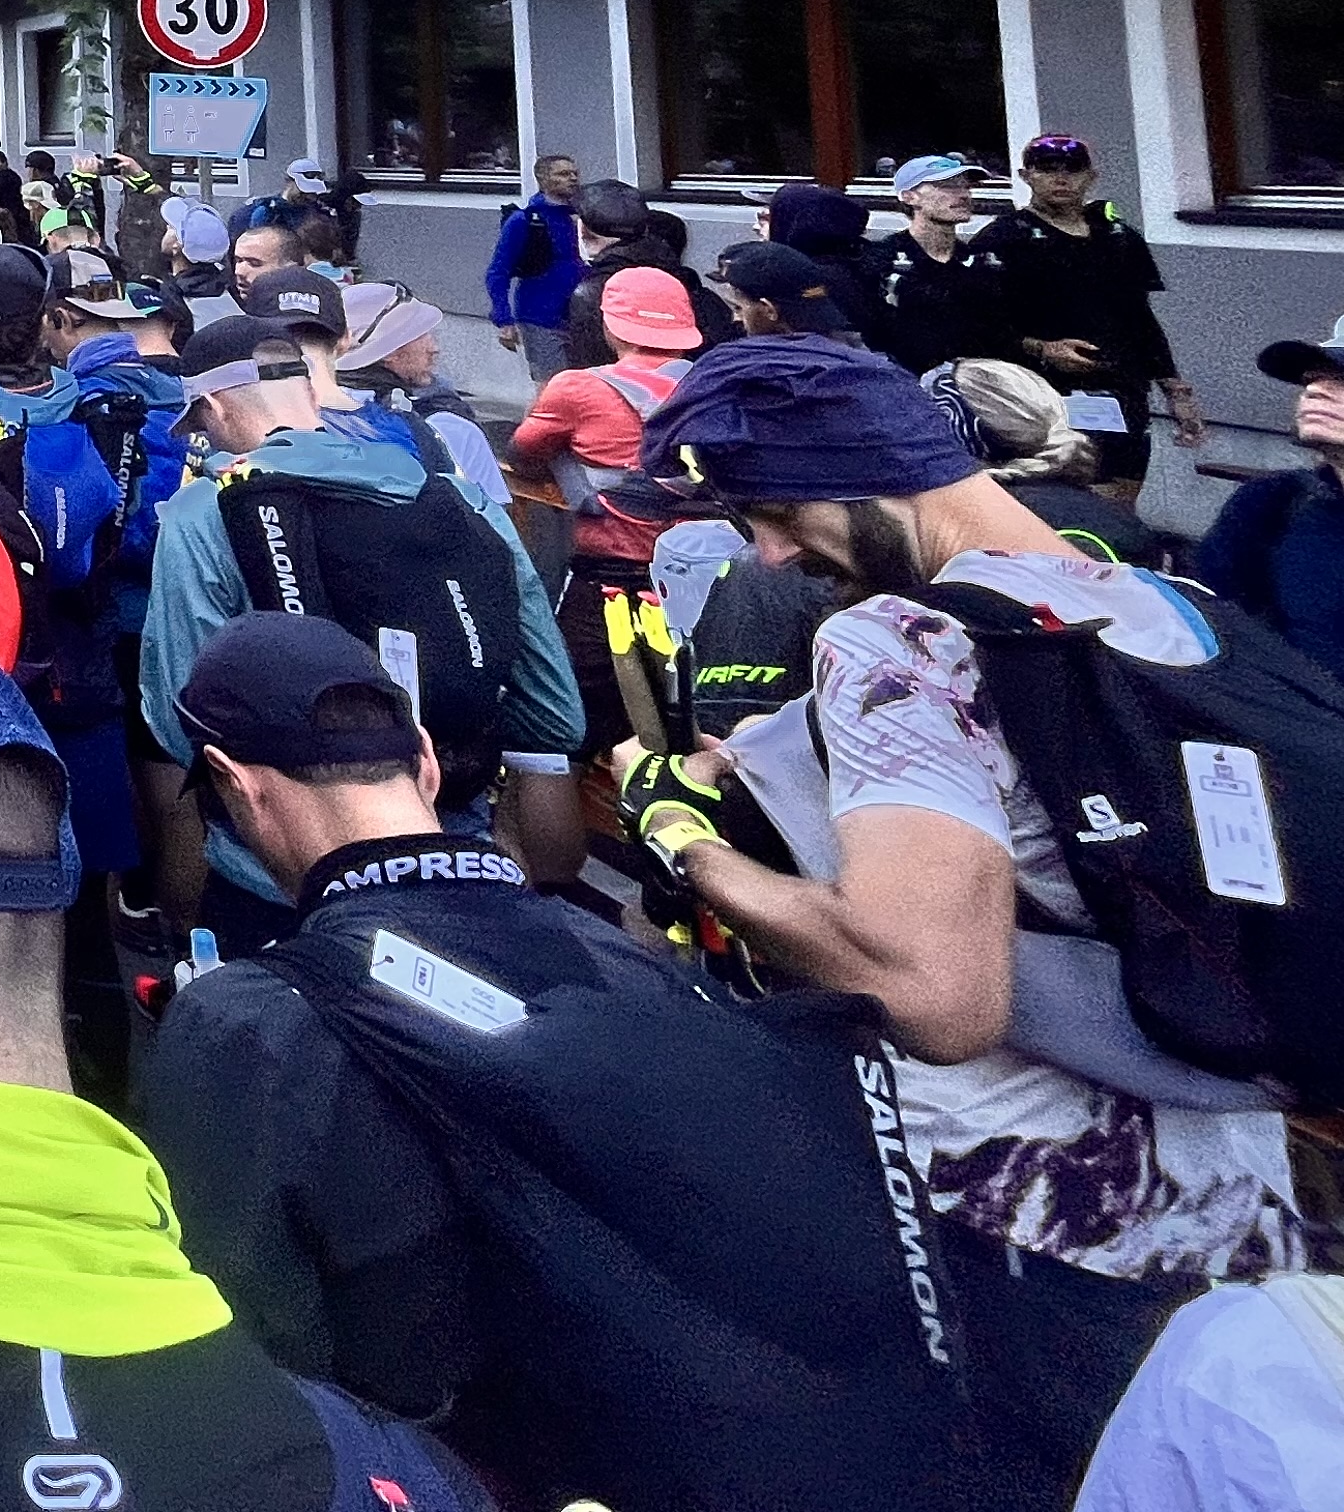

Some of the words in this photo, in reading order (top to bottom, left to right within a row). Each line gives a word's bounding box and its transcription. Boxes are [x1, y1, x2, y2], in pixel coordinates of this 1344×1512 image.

[114, 431, 135, 527] SALOMON
[258, 505, 305, 616] SALOMO
[446, 579, 484, 668] SALOMON
[853, 1044, 950, 1364] SALOMON
